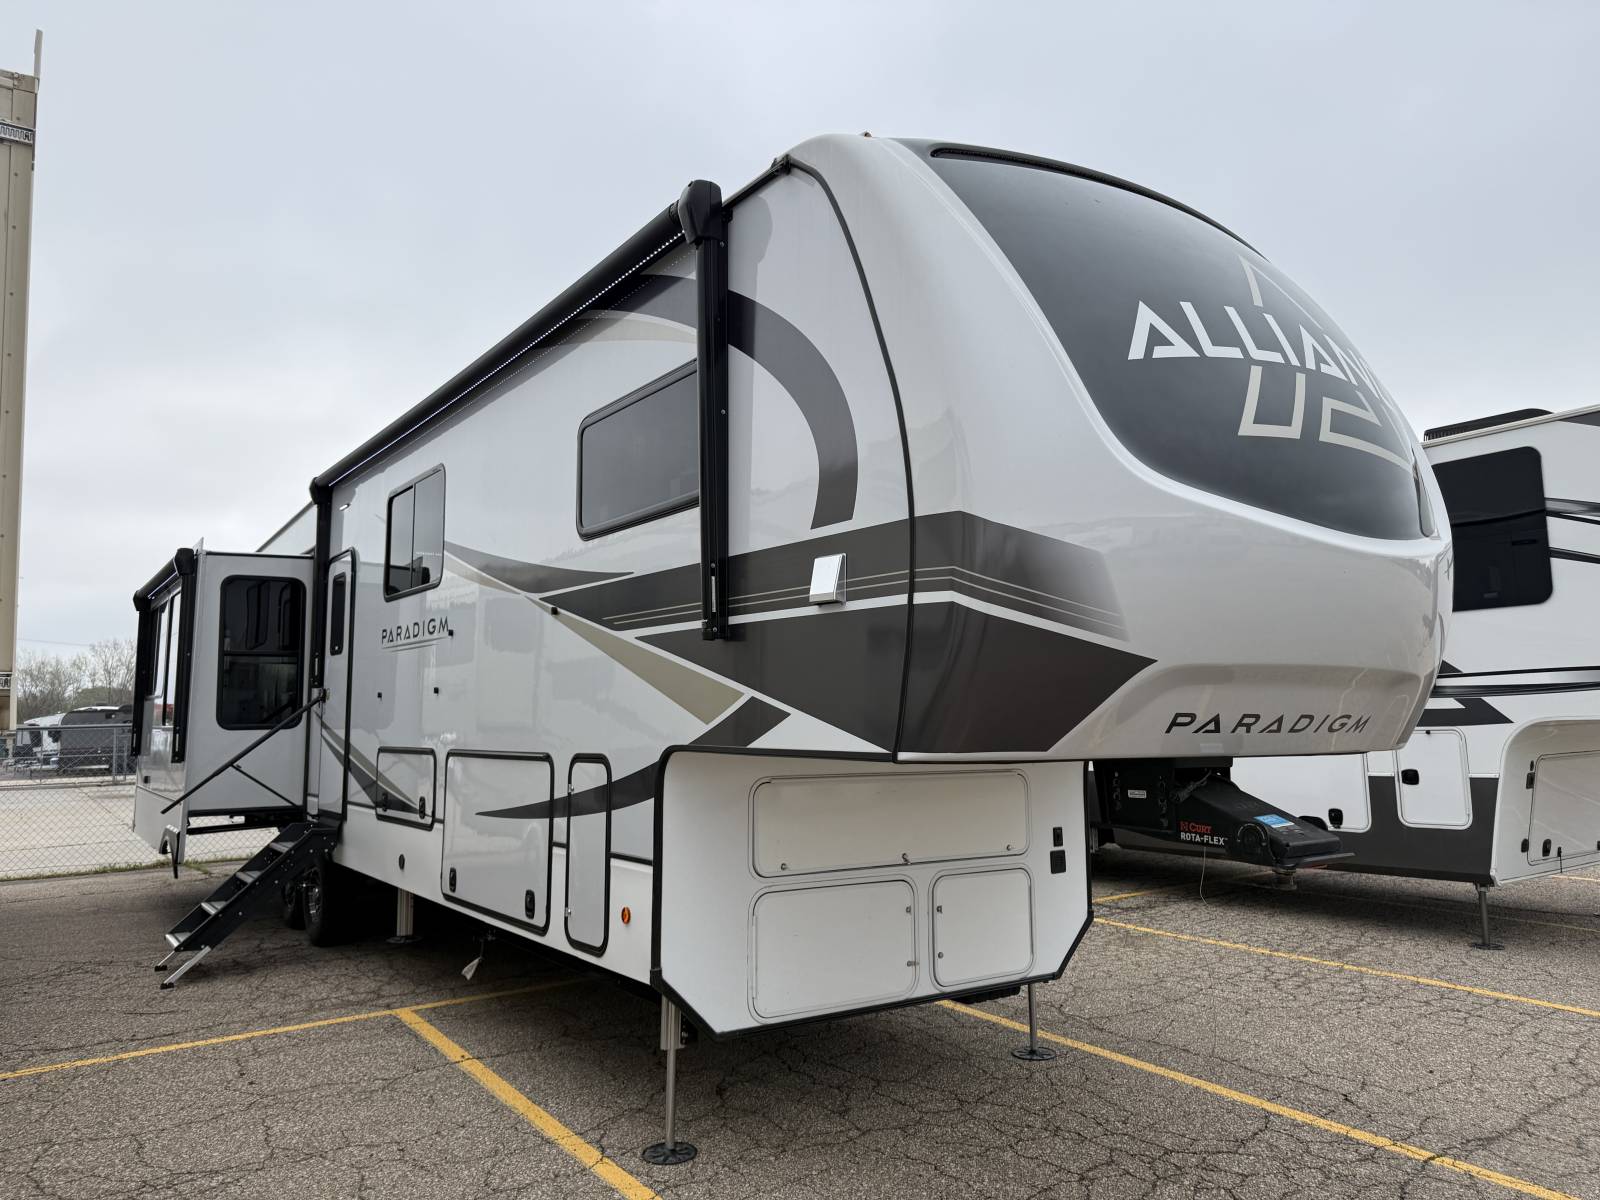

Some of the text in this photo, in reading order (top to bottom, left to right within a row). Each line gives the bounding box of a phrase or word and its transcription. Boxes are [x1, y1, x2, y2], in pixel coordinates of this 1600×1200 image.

[1127, 300, 1386, 402] ALLIAN
[381, 616, 449, 644] PARADIGM
[1165, 712, 1371, 734] PARADIGM
